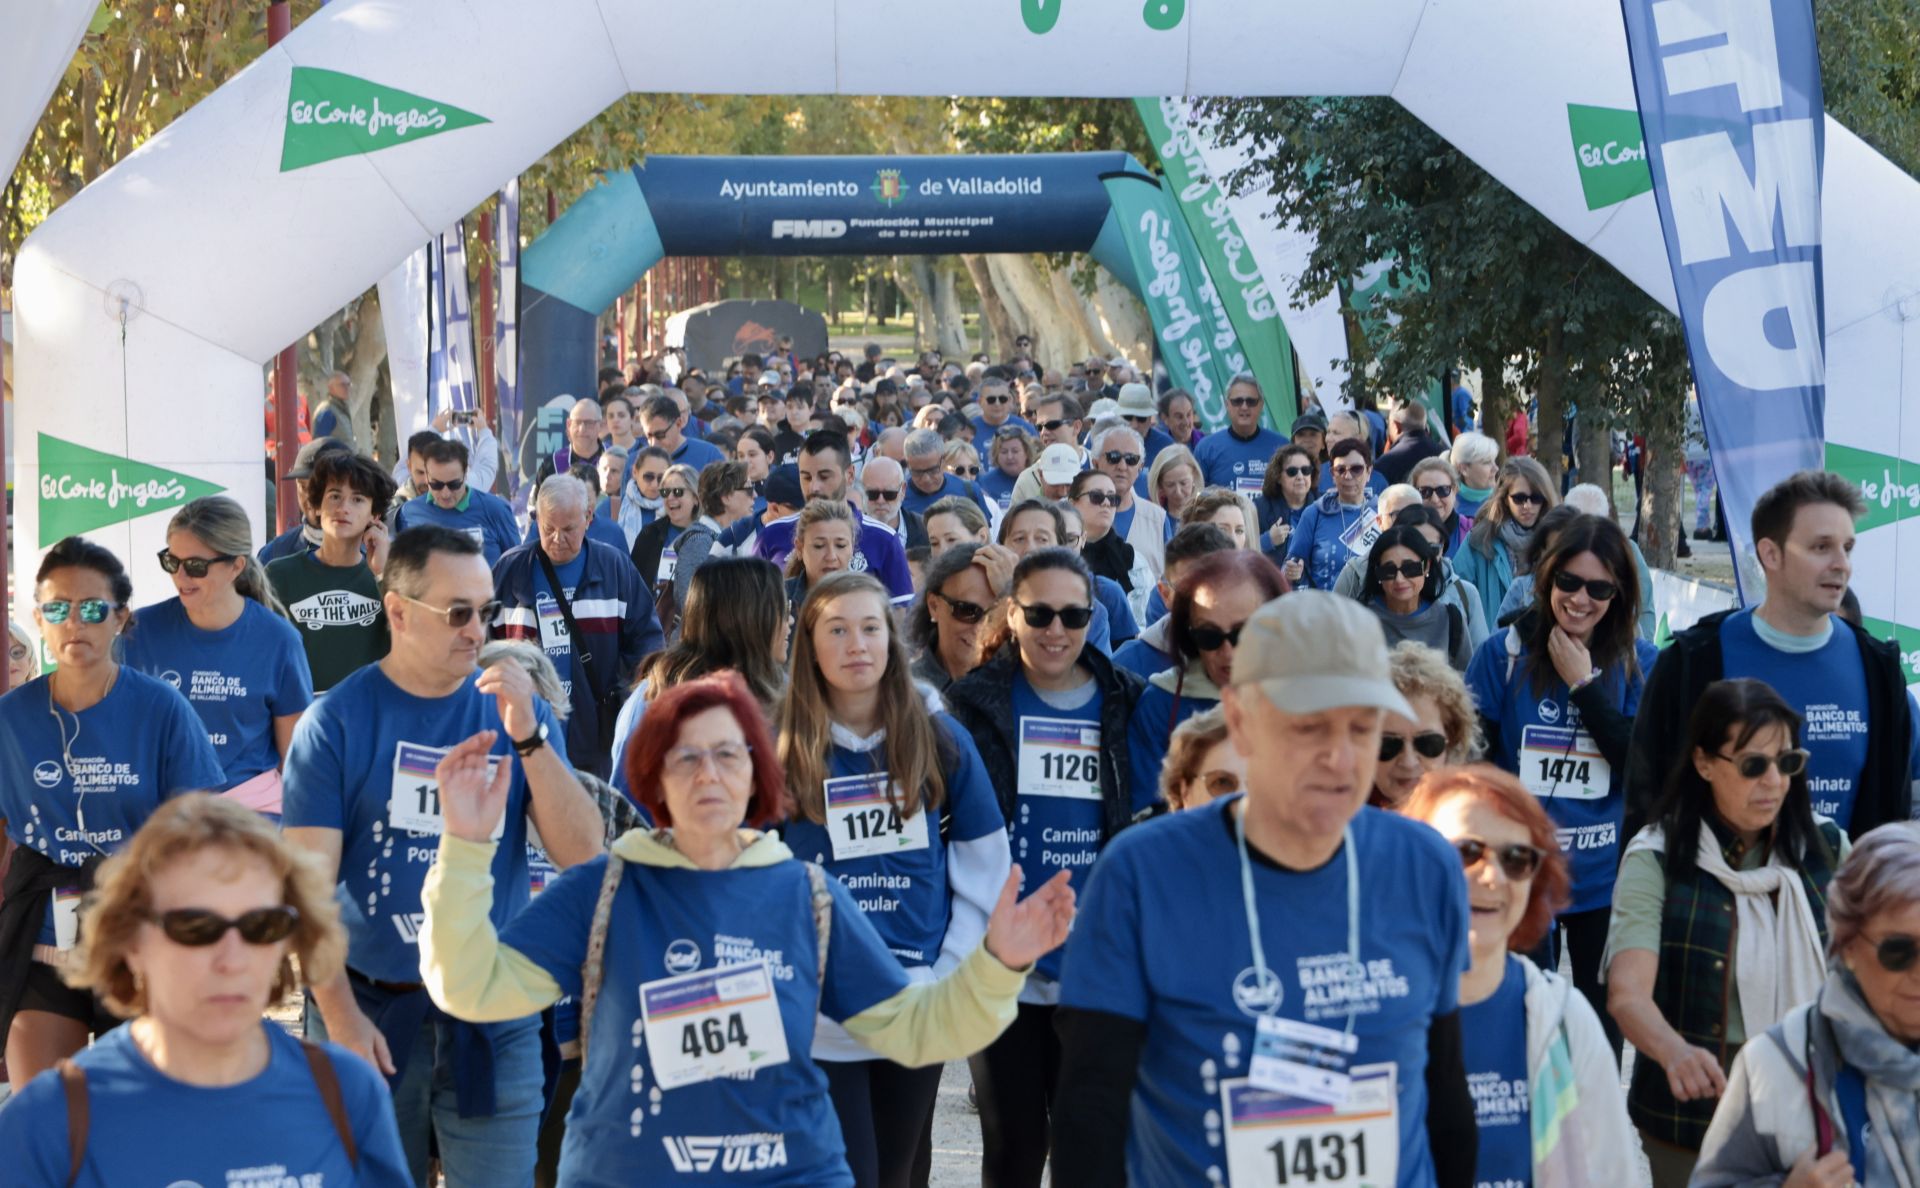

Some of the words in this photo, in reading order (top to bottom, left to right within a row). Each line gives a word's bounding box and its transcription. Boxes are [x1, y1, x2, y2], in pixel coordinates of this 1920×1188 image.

[291, 100, 313, 124] El
[314, 100, 366, 126] Corte
[368, 96, 447, 136] Inglés
[1579, 143, 1604, 167] El
[719, 179, 859, 200] Ayuntamiento
[919, 178, 943, 196] de
[947, 176, 1042, 196] Valladolid
[771, 218, 847, 239] FMD
[850, 216, 920, 228] Fundación
[923, 215, 994, 228] Municipal
[878, 229, 896, 238] de
[899, 229, 971, 239] Deportes
[41, 473, 57, 499] El
[57, 475, 106, 499] Corte
[107, 468, 186, 508] Inglés
[1361, 526, 1382, 548] 451
[317, 593, 350, 607] VANS
[321, 606, 345, 621] THE
[190, 685, 247, 697] ALIMENTOS
[191, 675, 225, 686] BANCO
[227, 677, 241, 687] DE
[1806, 711, 1845, 722] BANCO
[1846, 710, 1861, 722] DE
[1807, 722, 1868, 733] ALIMENTOS
[74, 763, 113, 775] BANCO
[114, 763, 130, 774] DE
[1040, 752, 1098, 783] 1126
[1538, 757, 1591, 785] 1474
[74, 773, 140, 785] ALIMENTOS
[842, 808, 904, 841] 1124
[1576, 821, 1616, 834] COMERCIAL
[1576, 829, 1617, 850] ULSA
[1303, 975, 1410, 1007] ALIMENTOS
[681, 1011, 749, 1059] 464
[721, 1142, 788, 1173] ULSA
[1267, 1128, 1367, 1185] 1431
